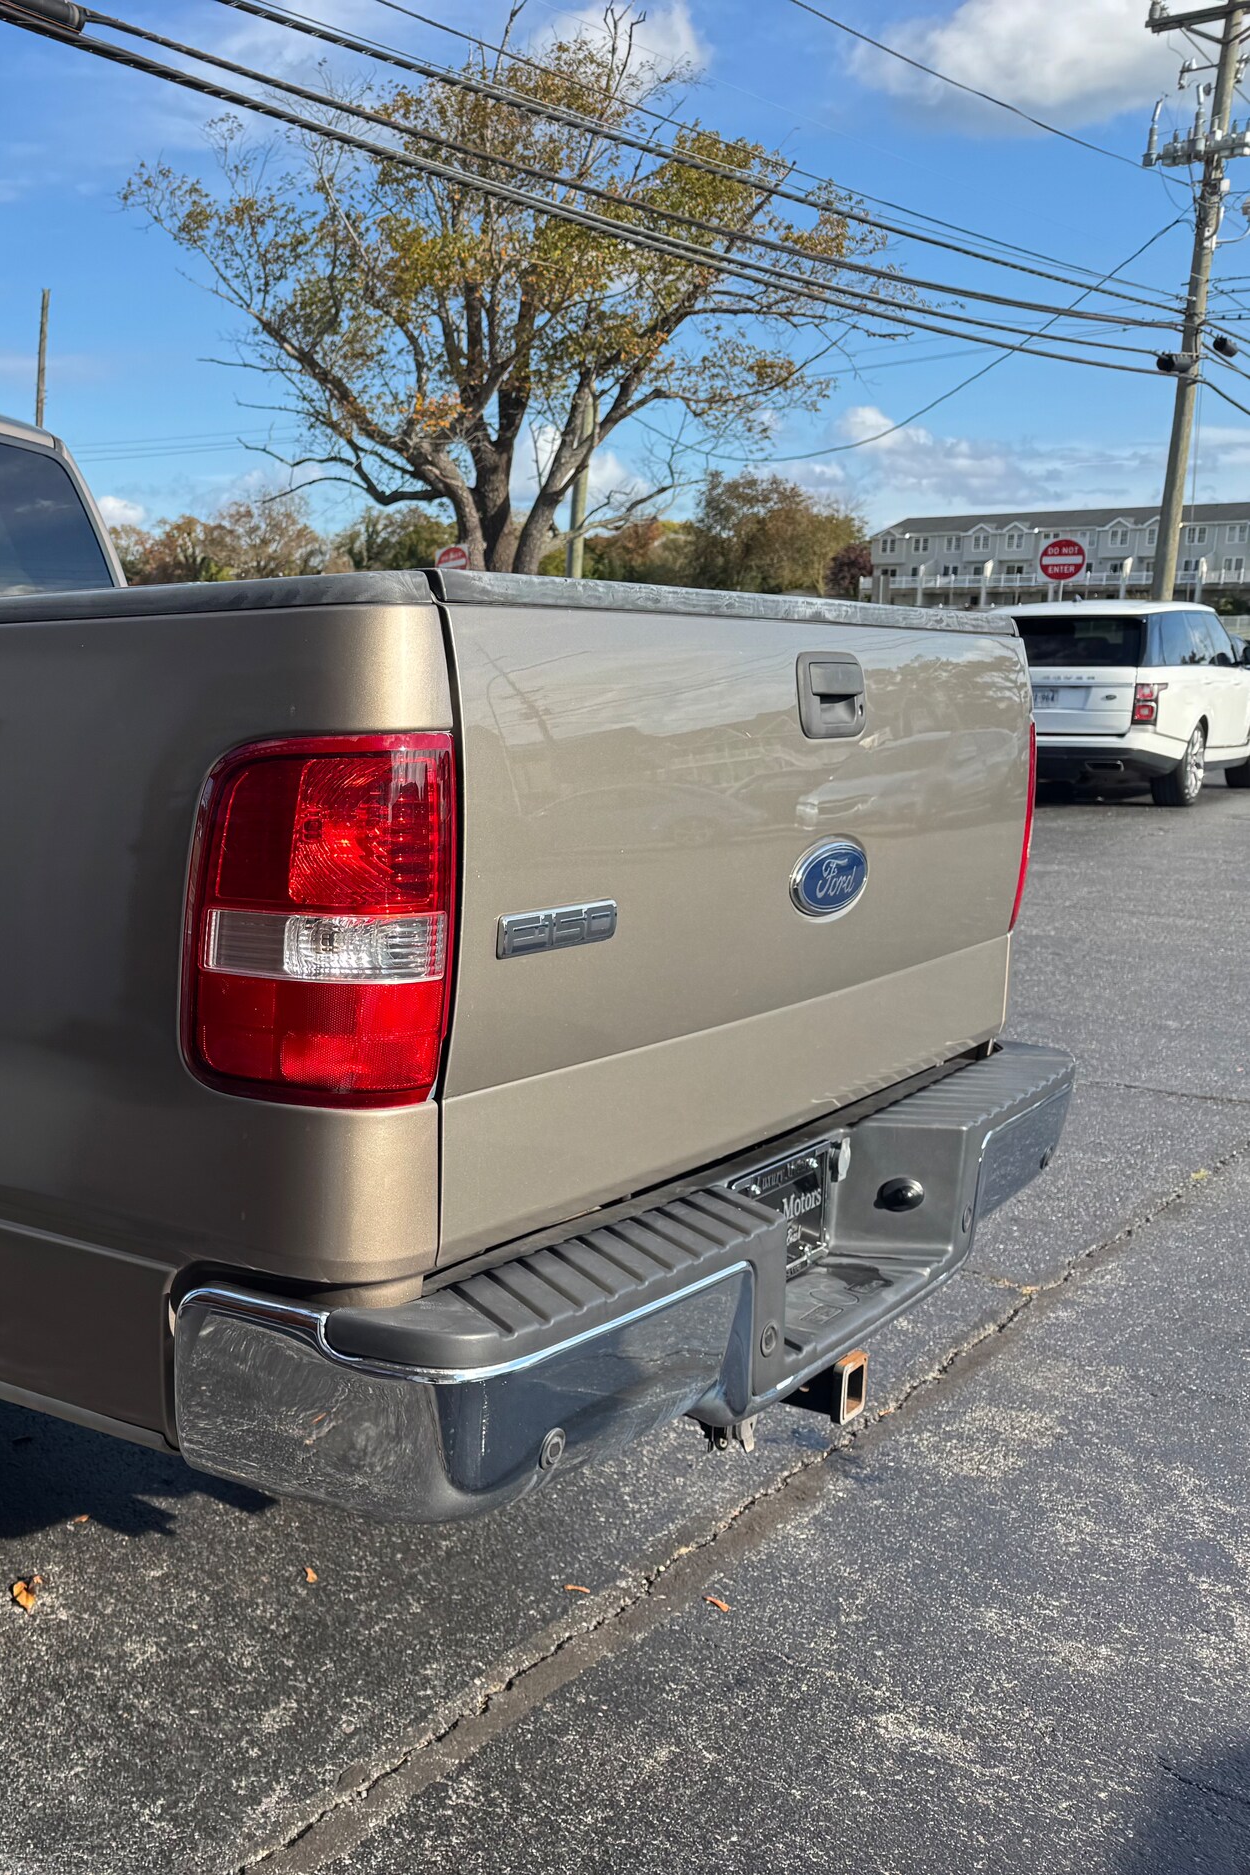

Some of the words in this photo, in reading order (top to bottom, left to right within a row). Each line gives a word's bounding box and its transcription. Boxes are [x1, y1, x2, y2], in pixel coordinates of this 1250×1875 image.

[1048, 546, 1060, 555] DO
[1062, 546, 1079, 554] NOT
[1048, 564, 1075, 574] ENTER
[816, 858, 857, 899] Ford
[782, 1188, 822, 1219] Motors
